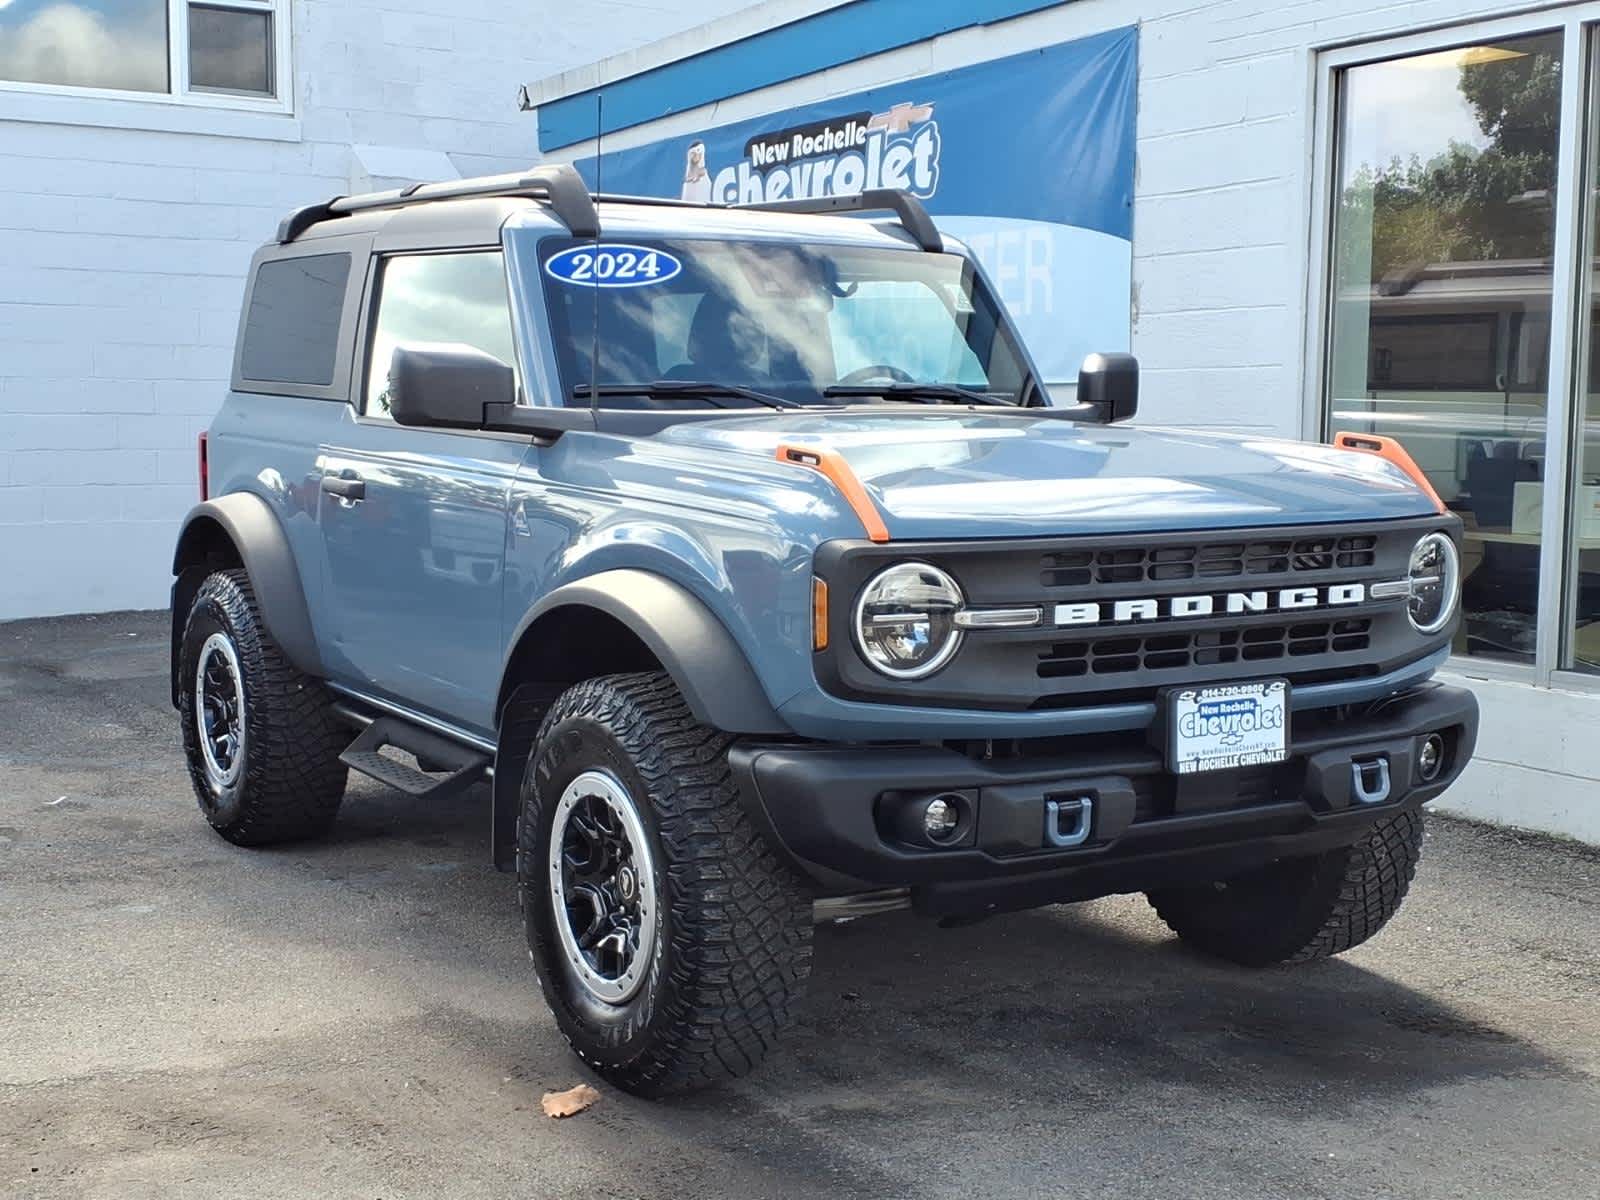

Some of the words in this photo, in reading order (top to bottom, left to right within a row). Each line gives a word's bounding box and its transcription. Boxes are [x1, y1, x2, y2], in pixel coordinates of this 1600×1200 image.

[751, 141, 790, 168] New
[792, 120, 867, 157] Rochelle
[712, 127, 936, 203] Chevrolet
[570, 252, 661, 280] 2024
[1054, 583, 1365, 625] BRONCO
[1179, 704, 1283, 738] Chevrolet
[1178, 759, 1198, 774] NEW
[1199, 753, 1239, 771] ROCHELLE
[1240, 750, 1285, 767] CHEVROLET
